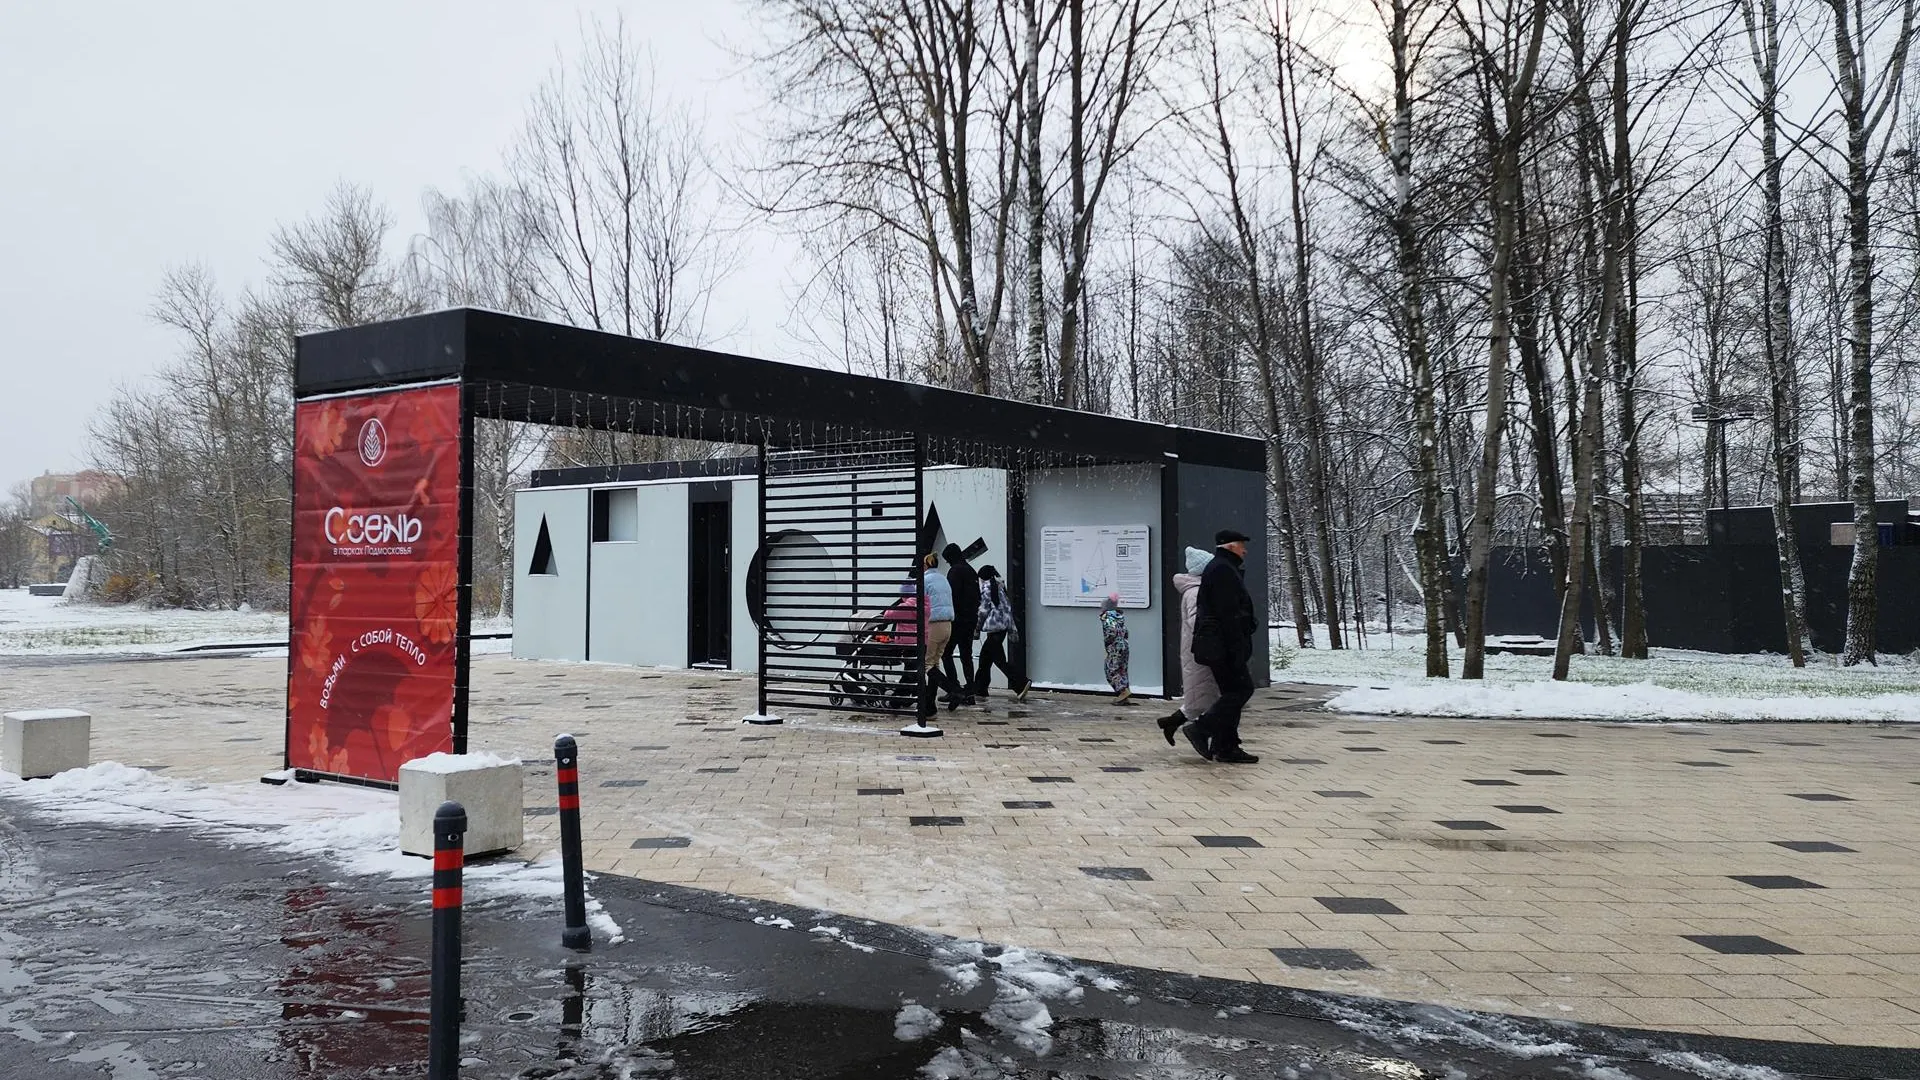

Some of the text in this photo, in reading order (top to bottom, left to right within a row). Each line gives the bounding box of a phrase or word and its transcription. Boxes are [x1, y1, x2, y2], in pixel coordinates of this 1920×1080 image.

[333, 545, 412, 557] в парках Подмосковья
[320, 628, 426, 709] ВОЗЬМИ С СОБОЙ ТЕПЛО
